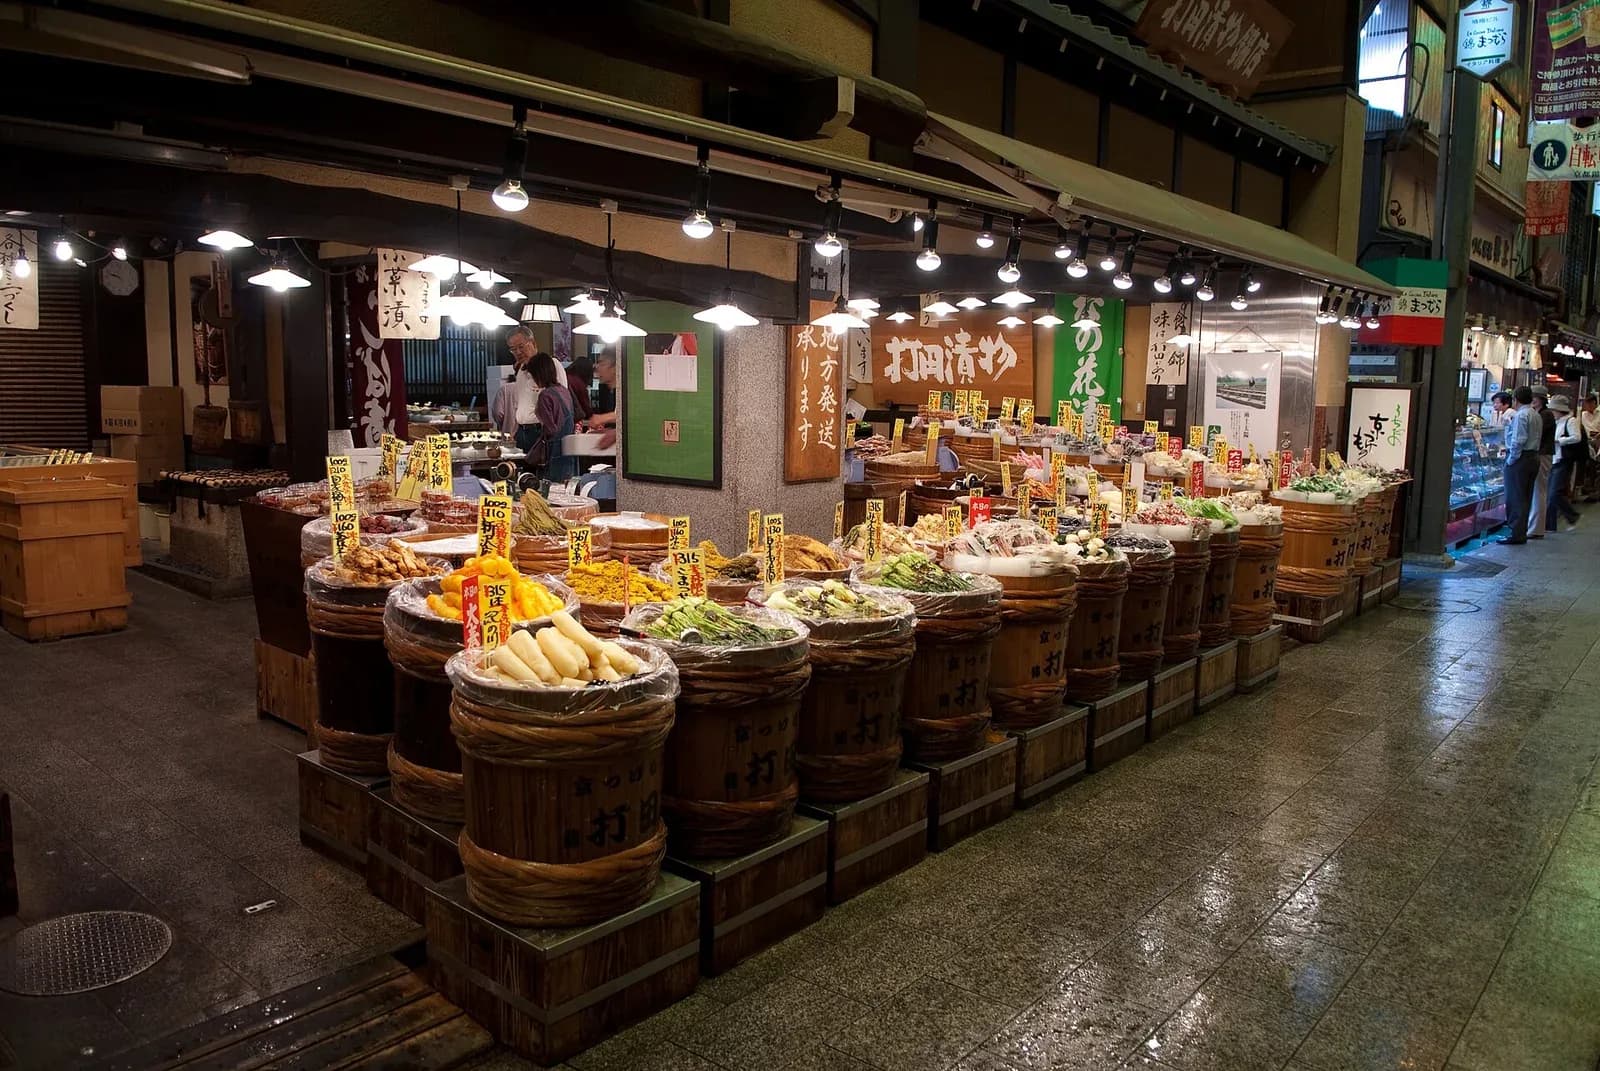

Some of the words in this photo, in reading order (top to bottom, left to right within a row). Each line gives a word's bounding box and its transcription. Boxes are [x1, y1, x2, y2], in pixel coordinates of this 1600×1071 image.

[1569, 144, 1600, 168] 自転
[796, 326, 818, 451] 承ります
[817, 326, 839, 450] 地方発送
[885, 328, 1018, 385] 打田漬物
